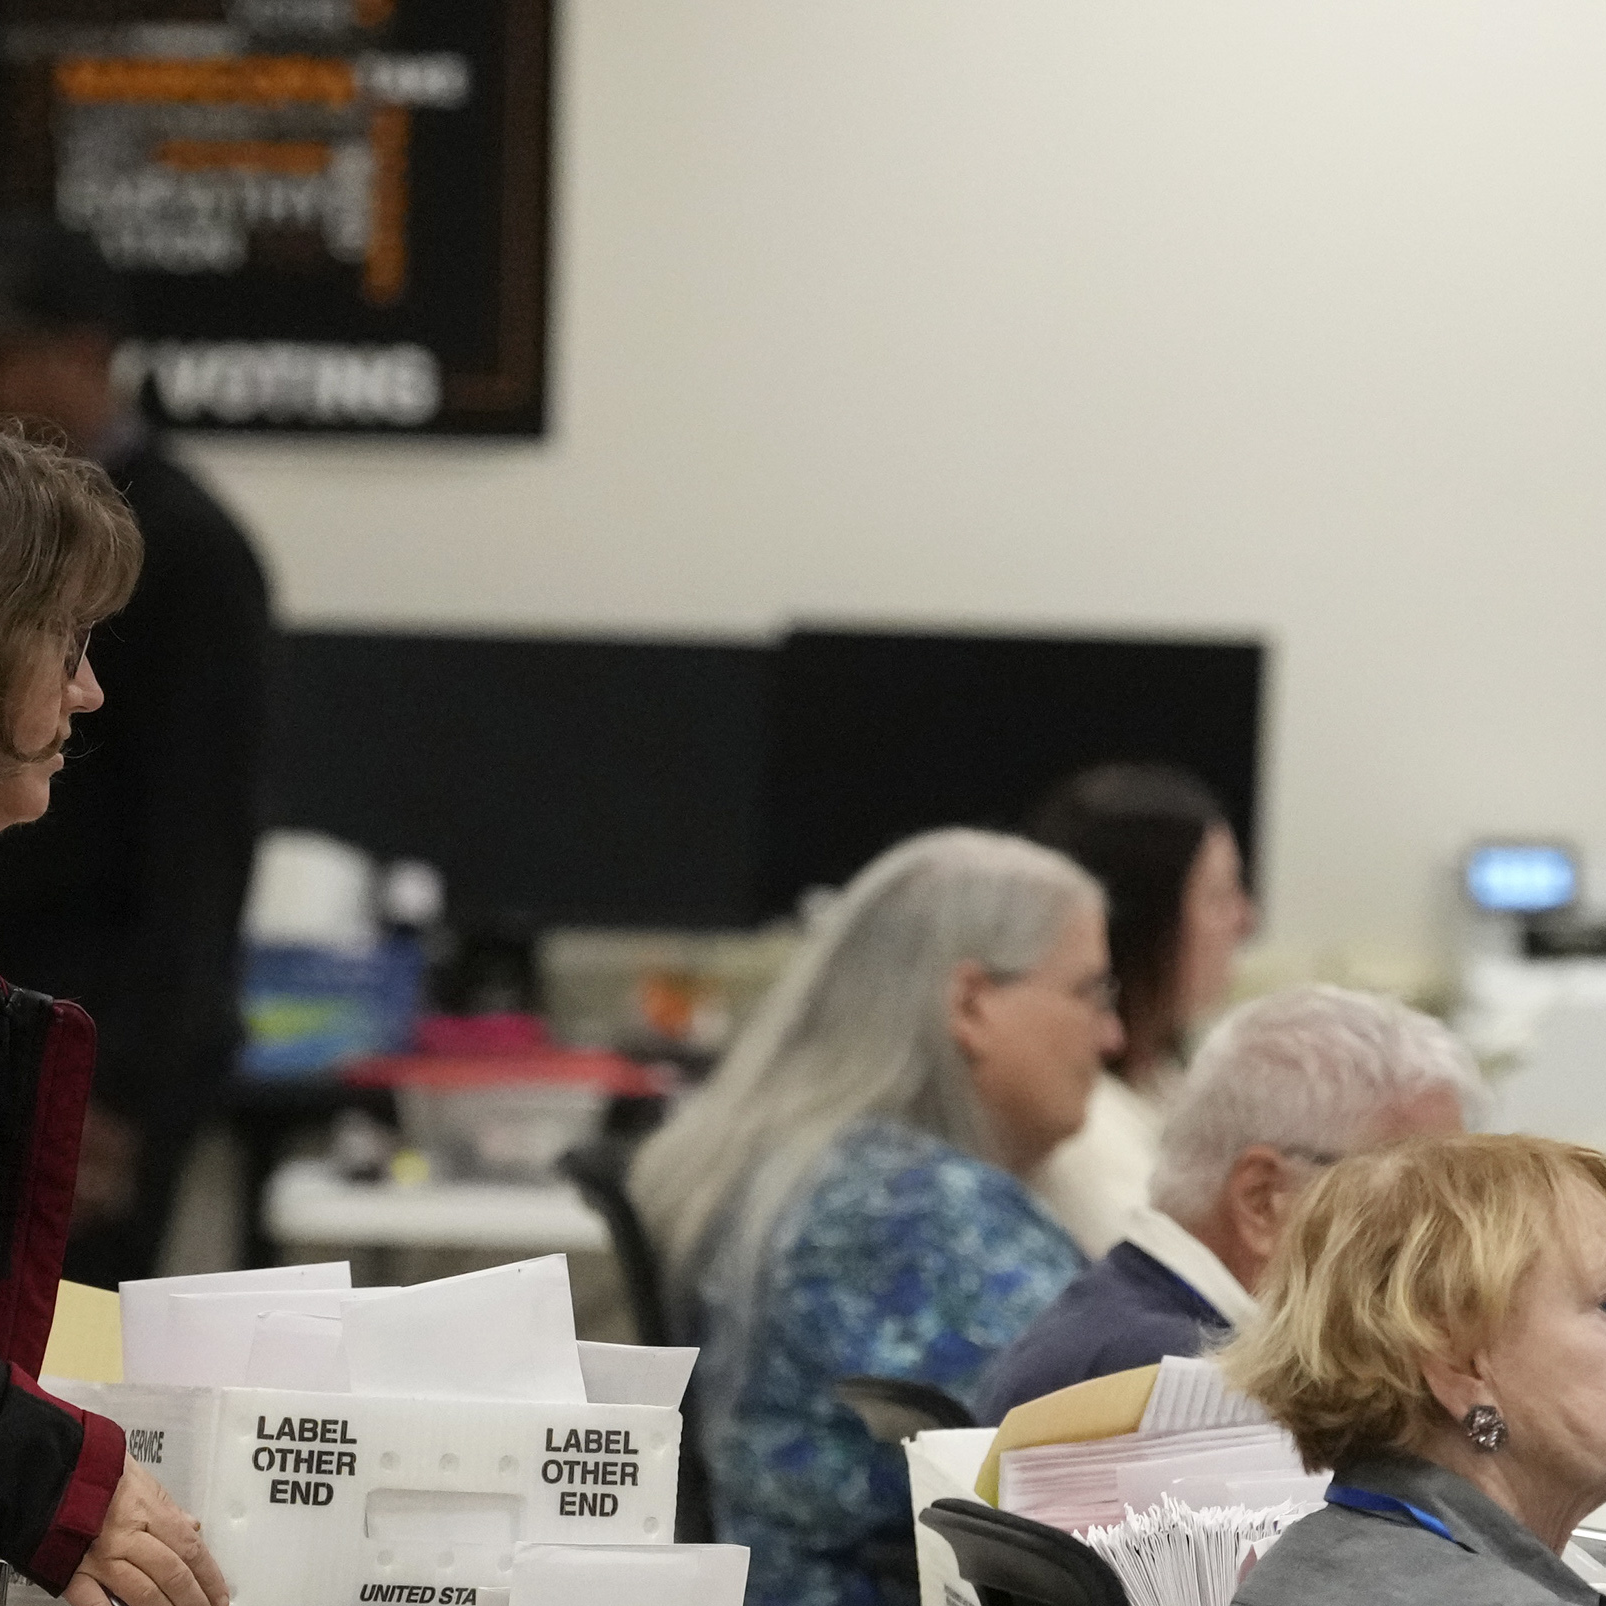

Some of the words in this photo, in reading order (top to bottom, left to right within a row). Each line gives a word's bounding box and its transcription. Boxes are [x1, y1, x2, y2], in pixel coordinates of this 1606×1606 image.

[256, 1416, 357, 1445] LABEL
[545, 1428, 639, 1455] LABEL
[129, 1429, 164, 1463] SERVICE
[252, 1447, 357, 1476] OTHER
[541, 1460, 639, 1486] OTHER
[269, 1479, 334, 1506] END
[559, 1492, 619, 1518] END
[359, 1584, 436, 1604] UNITED
[439, 1587, 477, 1606] STA
